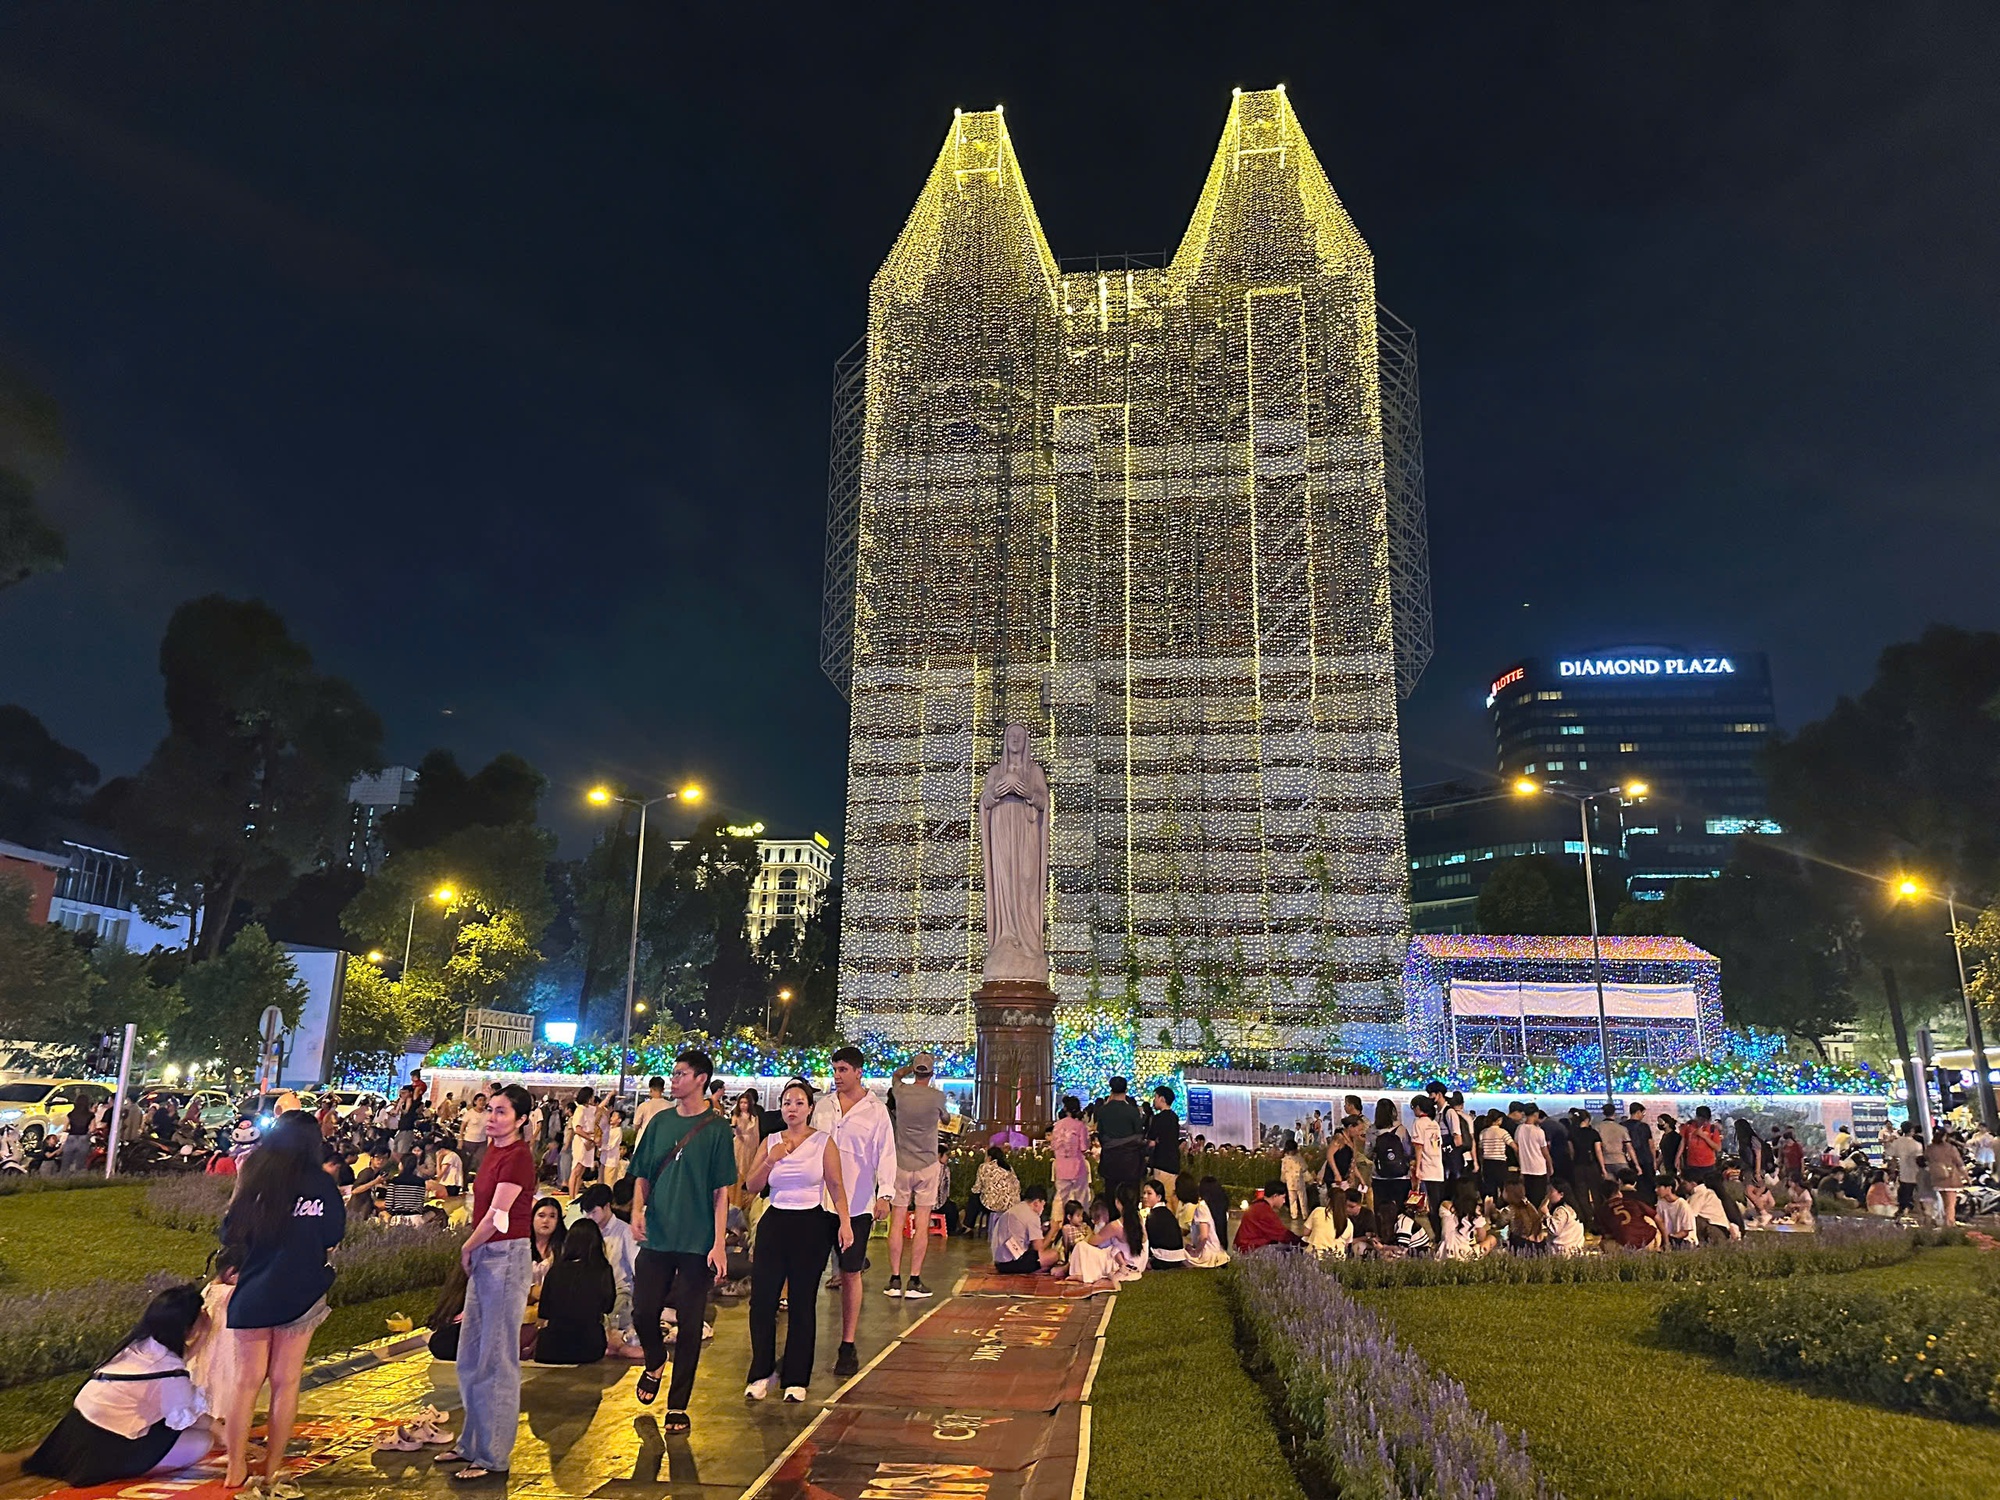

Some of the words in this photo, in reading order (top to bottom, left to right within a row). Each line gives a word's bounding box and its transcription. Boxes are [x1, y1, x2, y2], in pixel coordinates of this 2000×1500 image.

[1559, 659, 1660, 677] DIAMOND
[1665, 658, 1734, 674] PLAZA
[1496, 667, 1525, 690] LOTTE
[1613, 1204, 1632, 1225] 5
